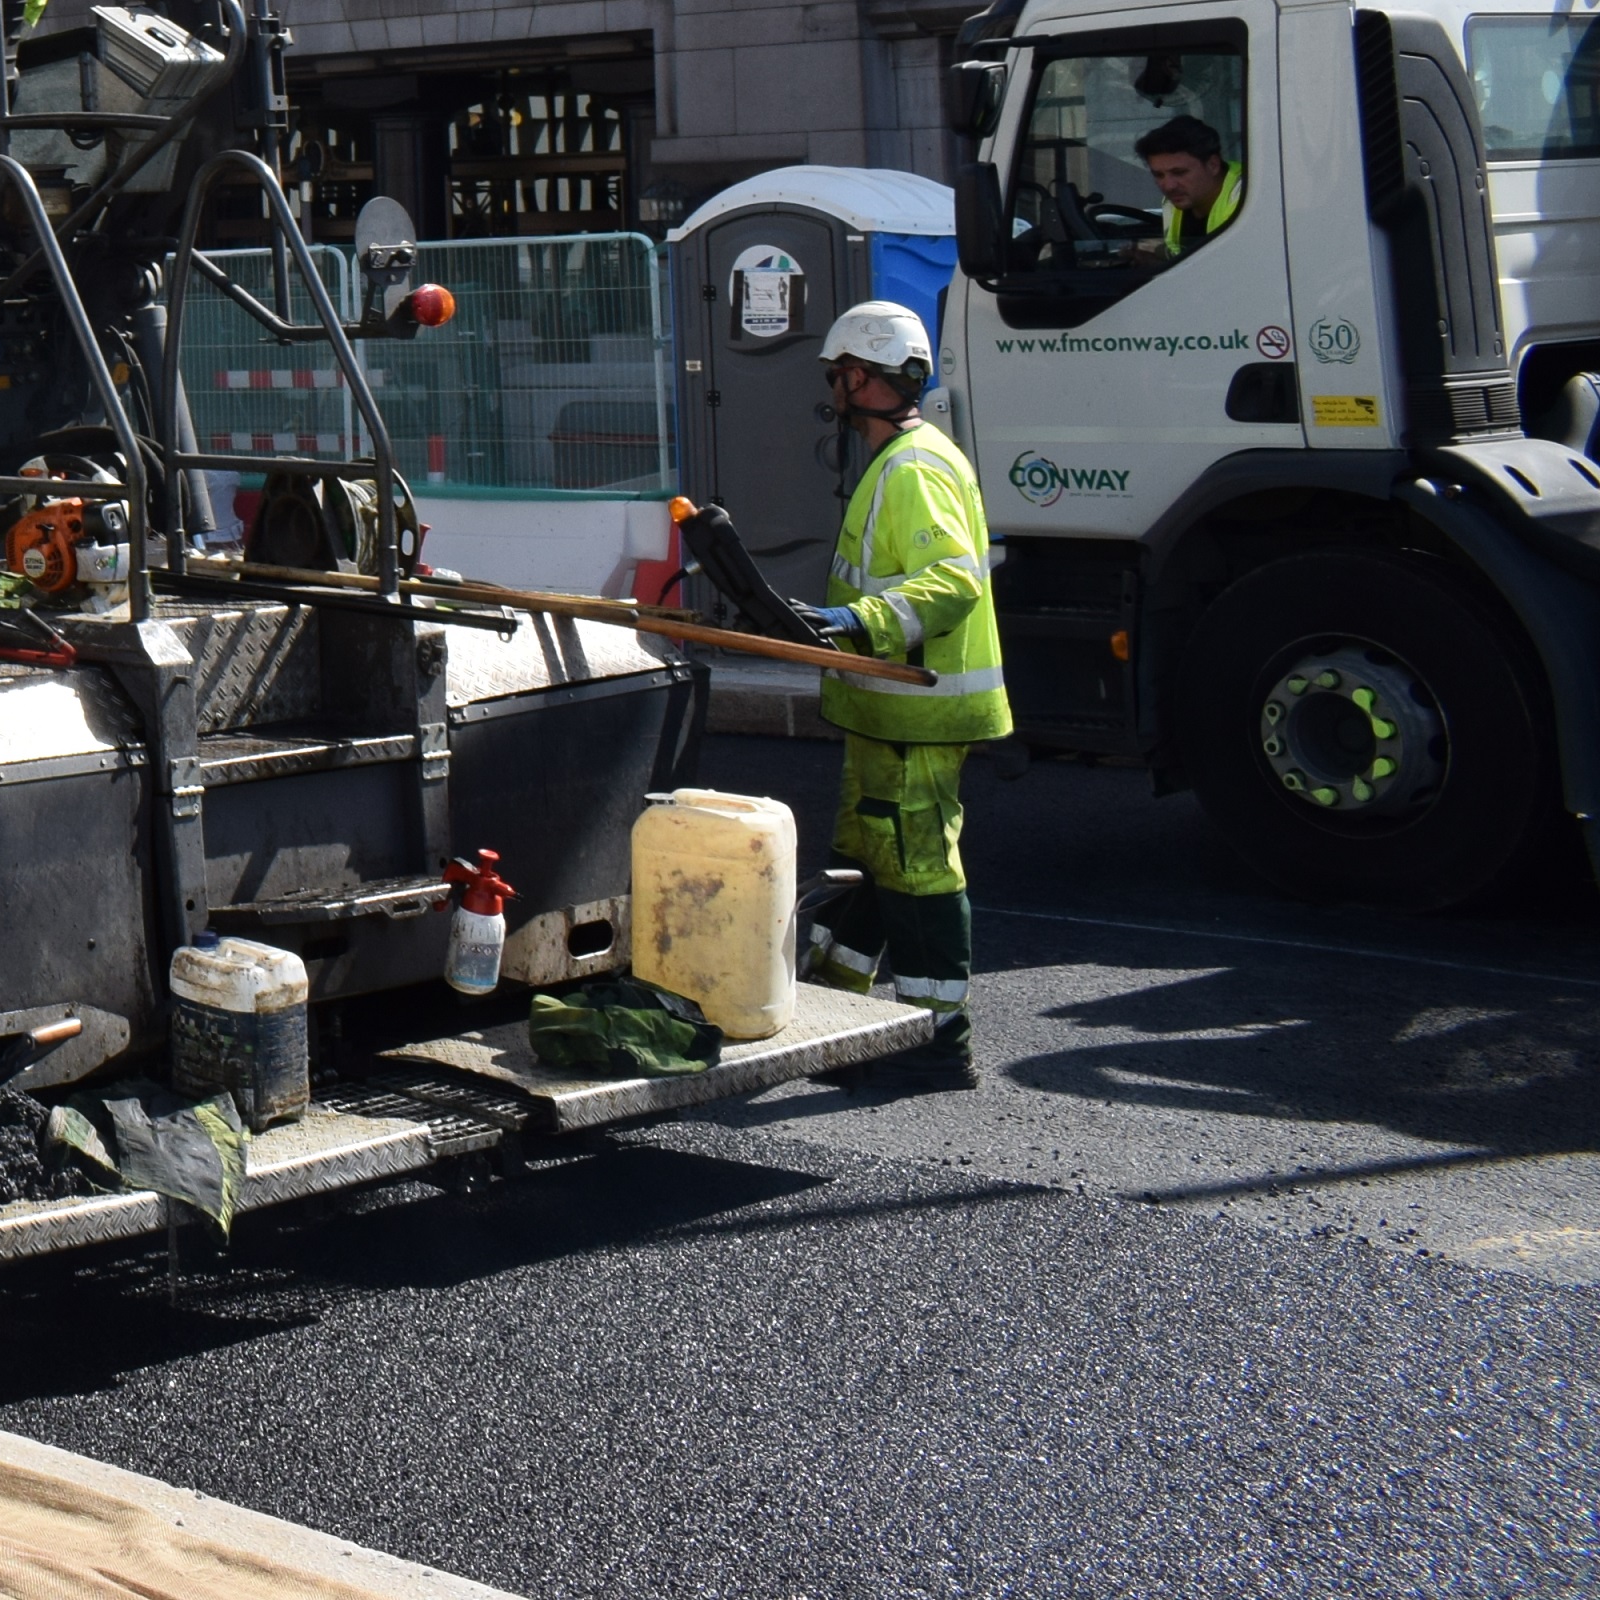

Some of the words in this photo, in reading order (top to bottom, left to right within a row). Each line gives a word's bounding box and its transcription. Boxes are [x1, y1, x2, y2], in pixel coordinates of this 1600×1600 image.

[996, 329, 1249, 357] www.fmconway.co.uk
[1318, 325, 1352, 350] 50
[1009, 466, 1130, 491] CONWAY
